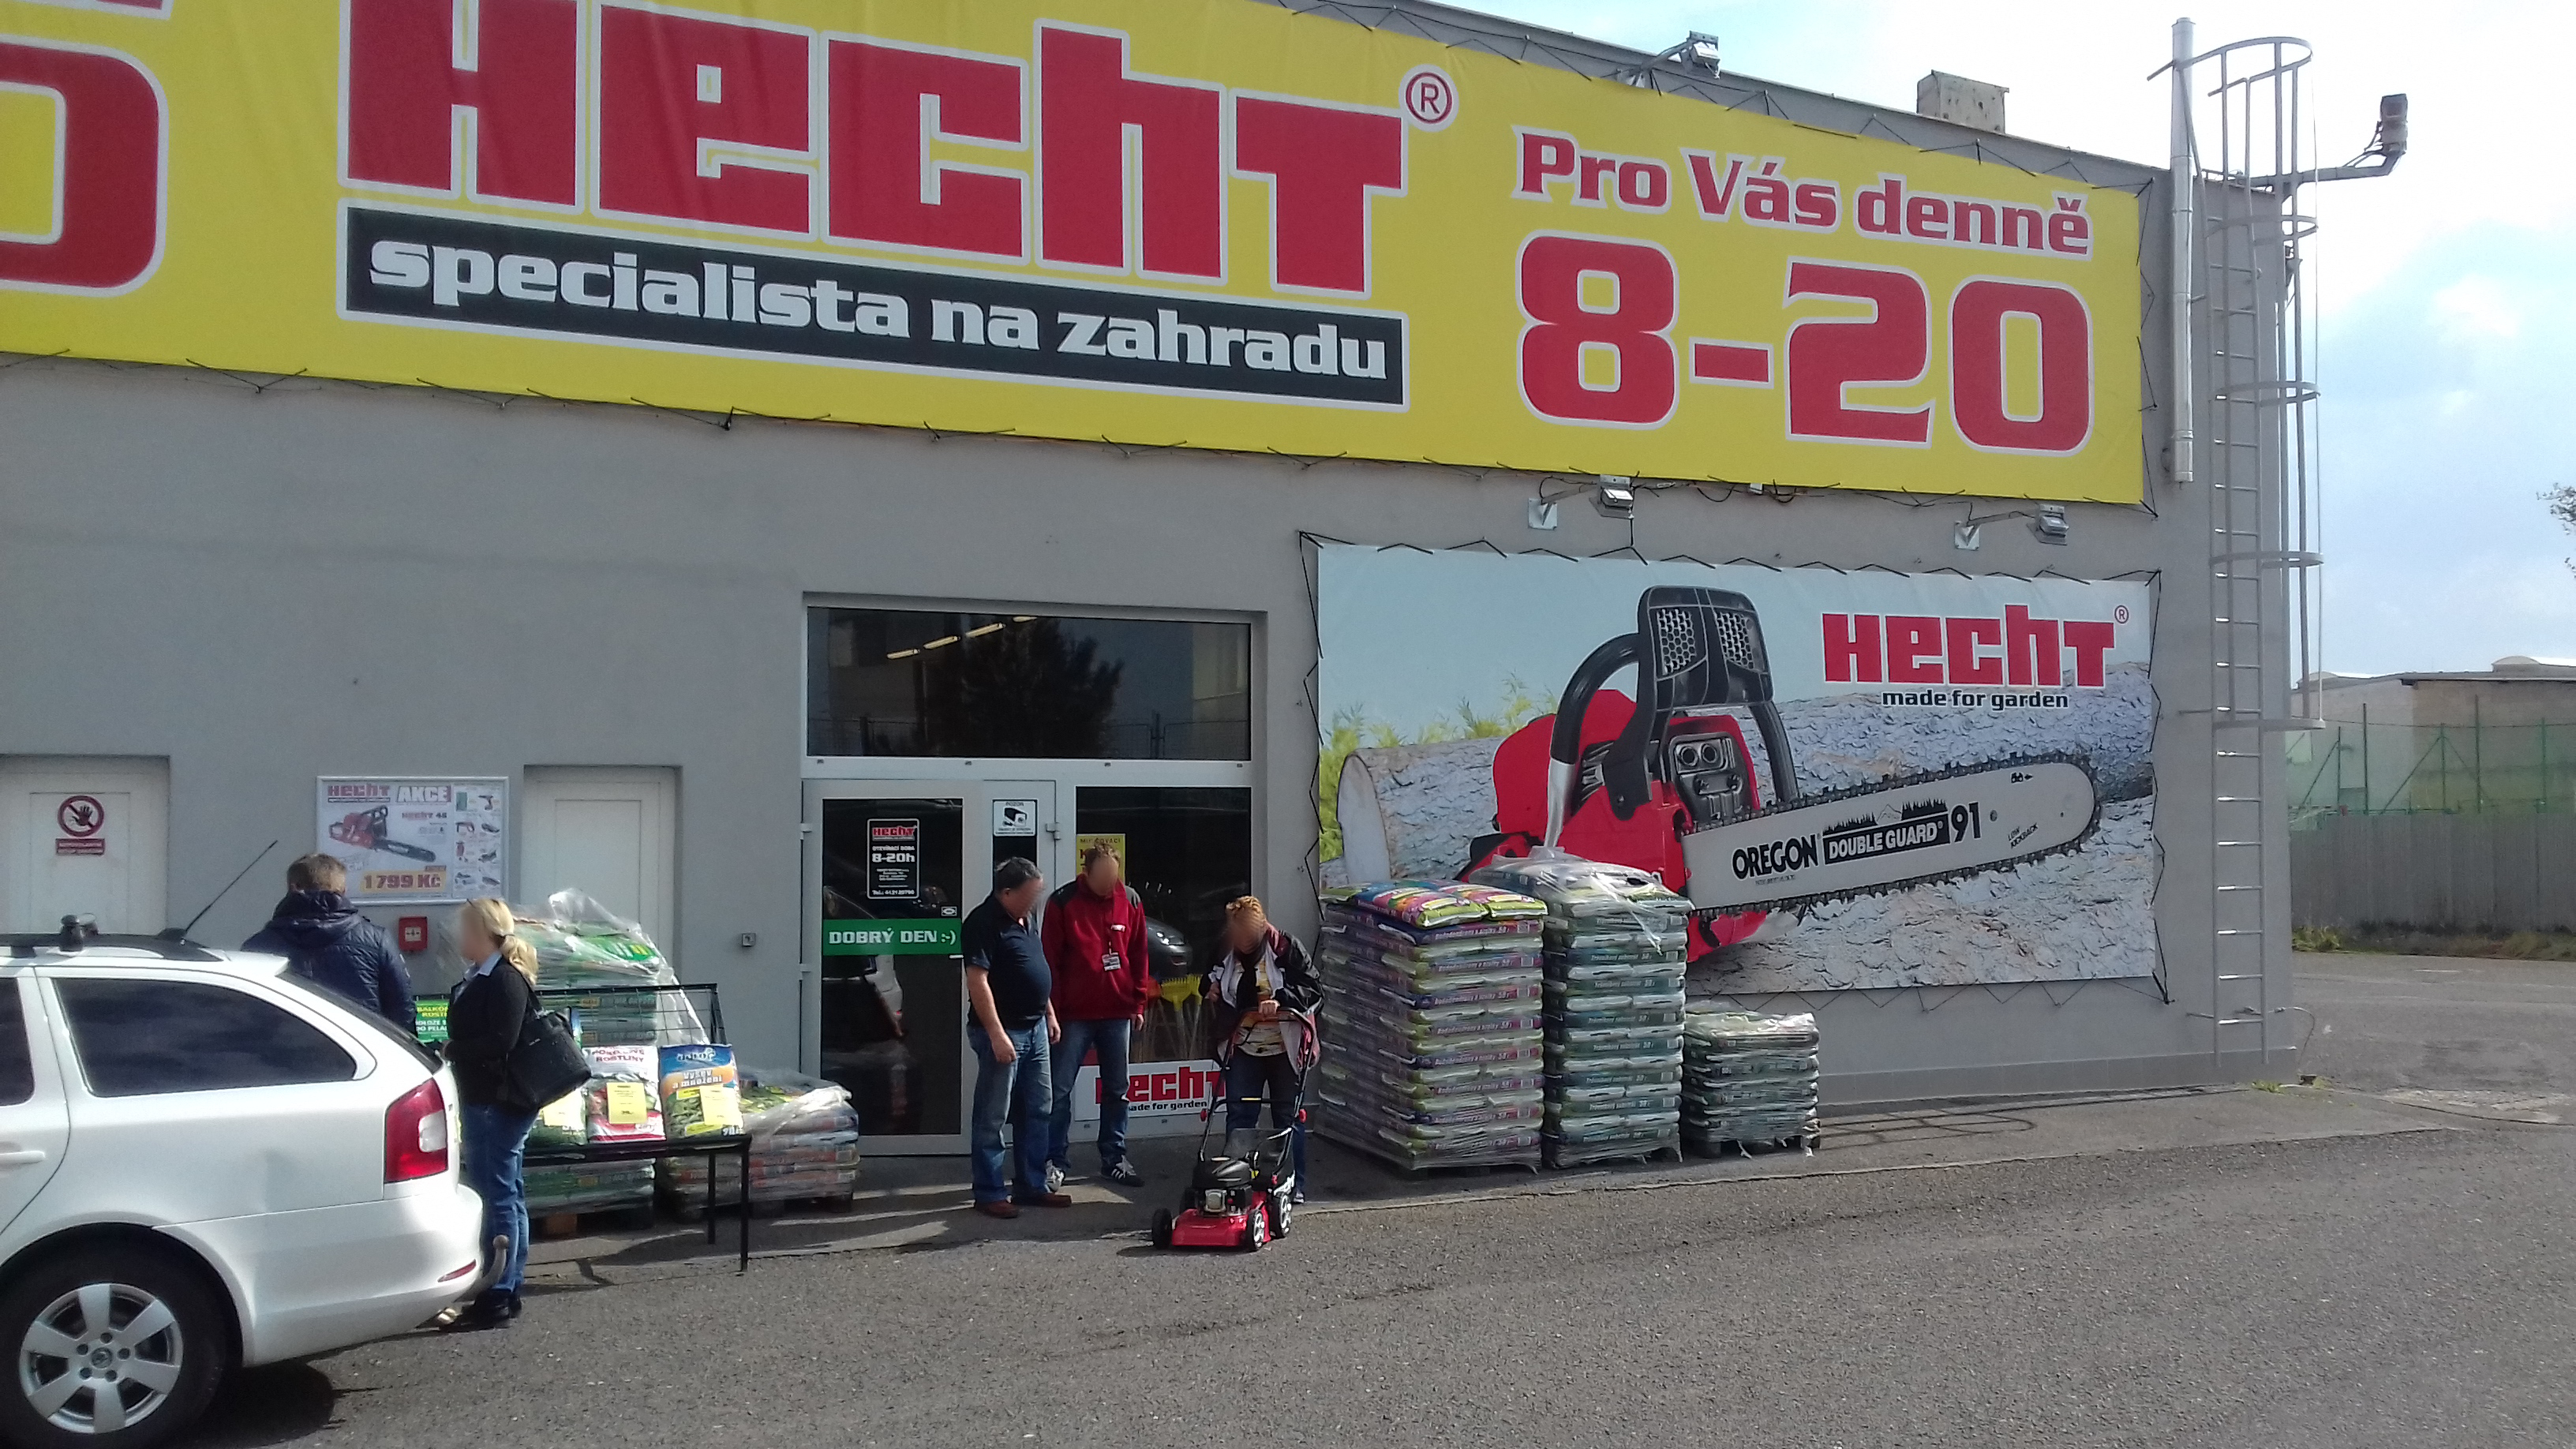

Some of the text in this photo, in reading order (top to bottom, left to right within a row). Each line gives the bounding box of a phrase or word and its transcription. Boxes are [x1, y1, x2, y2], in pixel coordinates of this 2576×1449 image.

[1520, 133, 2090, 254] Pro Vás denně
[369, 241, 1387, 380] specialista na zahradu
[1520, 236, 2090, 452] 8-20
[1883, 691, 2068, 710] made for garden
[397, 786, 449, 803] AKCE
[1732, 802, 1982, 879] OREGON DOUBLE GUARD 91
[872, 853, 915, 863] 8-20h
[417, 874, 441, 889] Kč
[829, 927, 894, 944] DOBRÝ
[900, 930, 938, 943] DEN
[1170, 1100, 1208, 1110] garden
